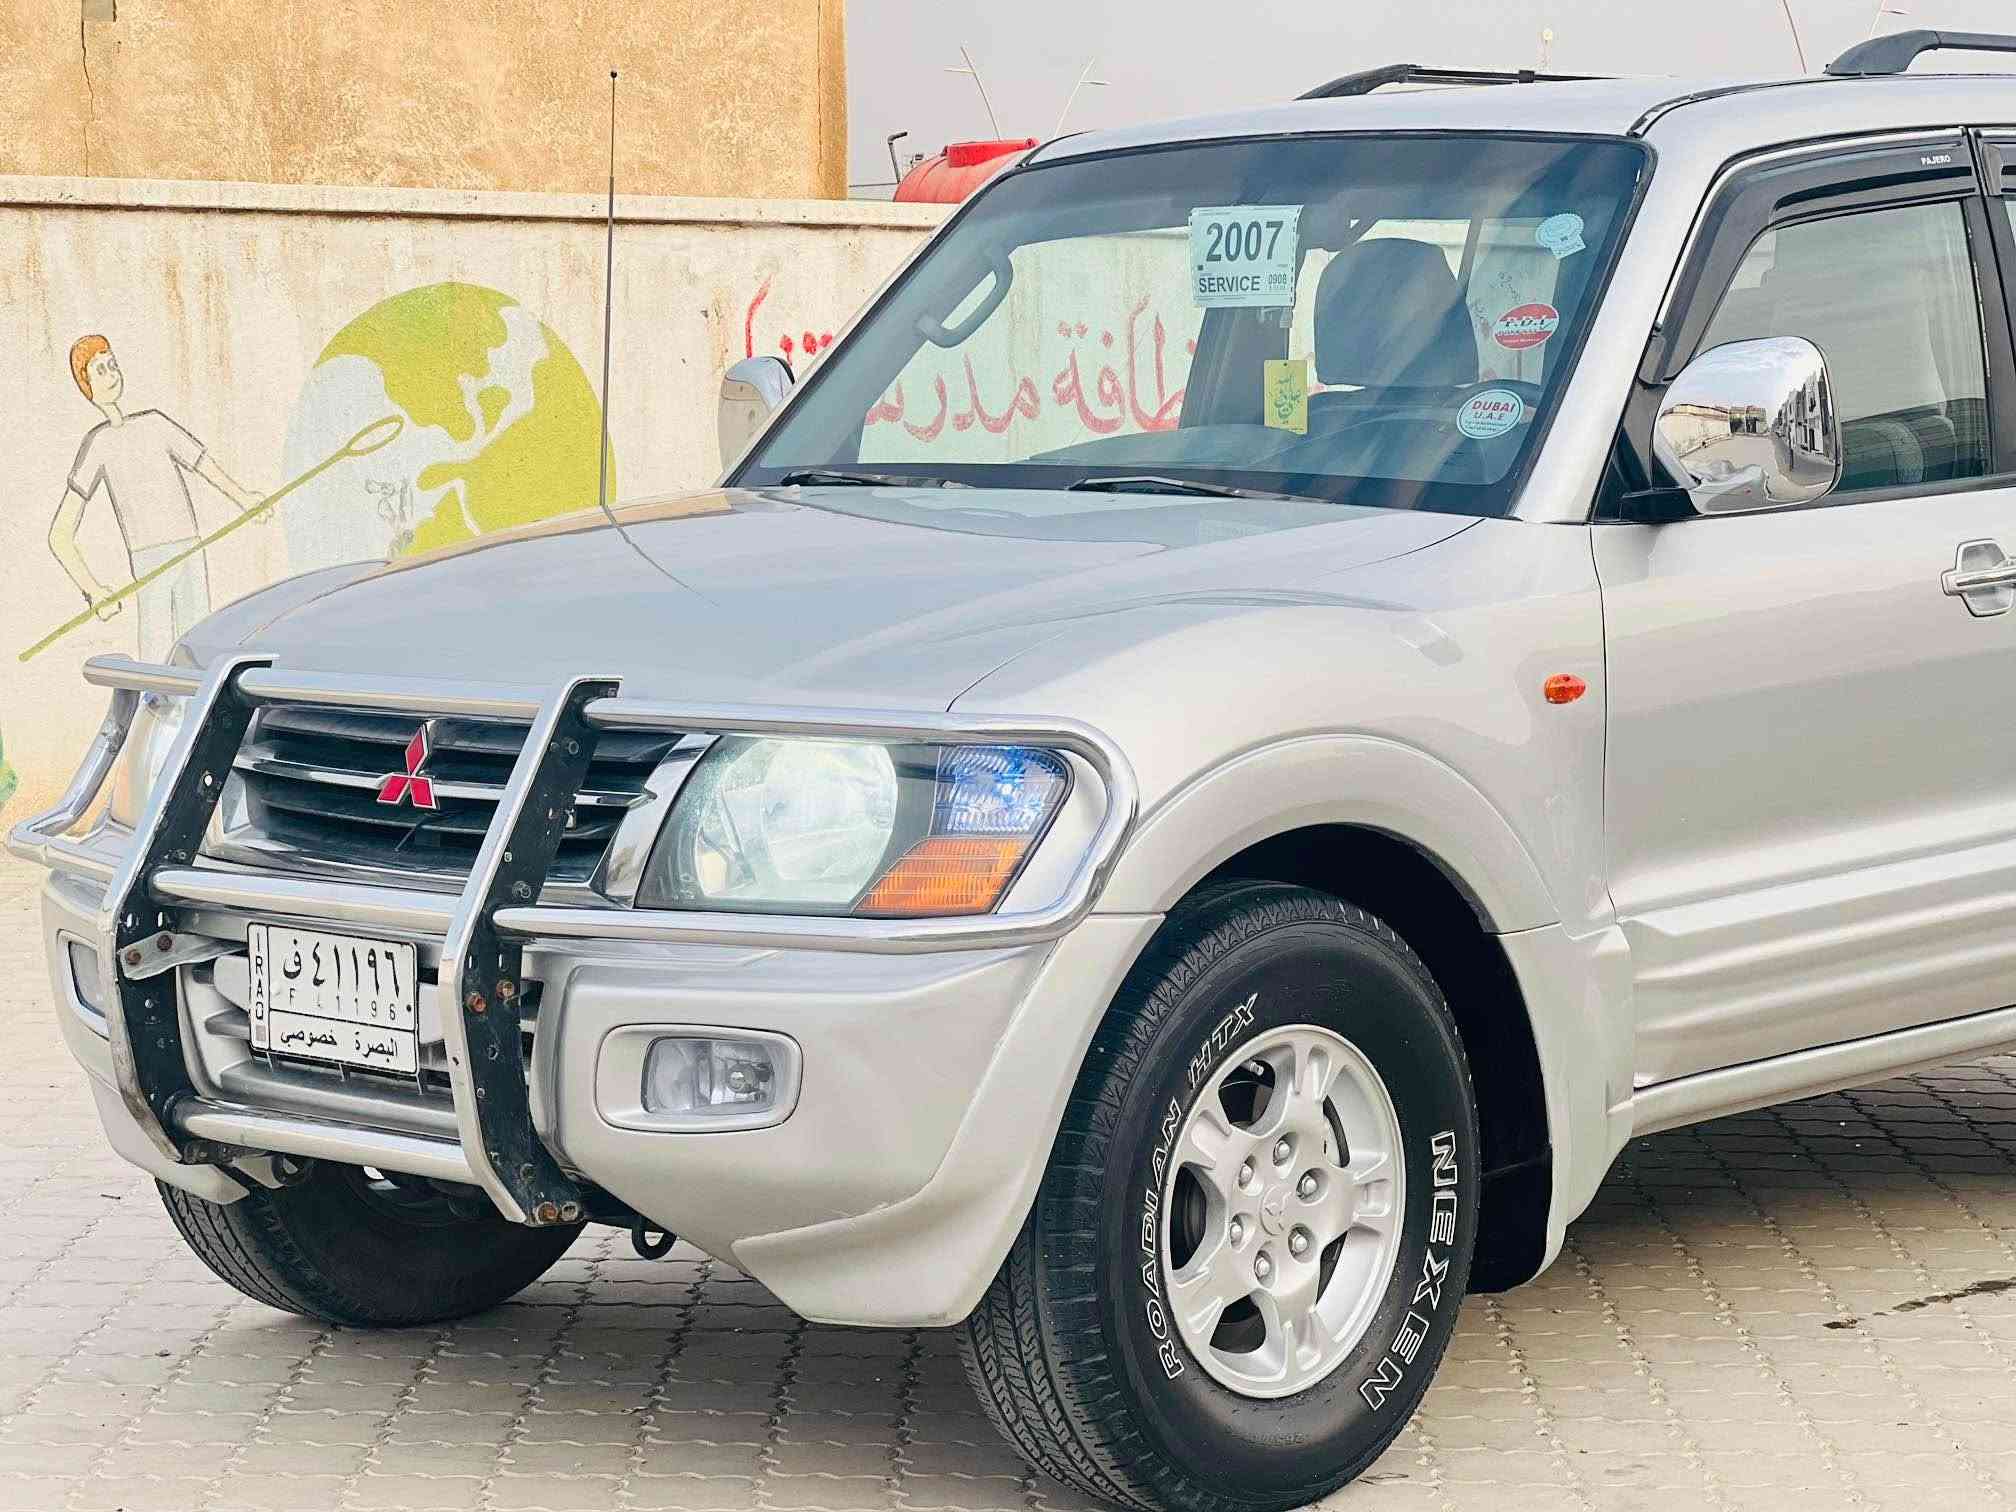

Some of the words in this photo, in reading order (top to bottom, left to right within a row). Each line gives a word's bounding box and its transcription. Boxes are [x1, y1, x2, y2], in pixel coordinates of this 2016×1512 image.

[1920, 154, 1952, 166] PAJERO
[1206, 220, 1284, 262] 2007
[1199, 275, 1261, 293] SERVICE
[1472, 400, 1516, 412] DUBAI
[255, 932, 264, 1021] IRAQ
[280, 1030, 338, 1048] خصوصي
[354, 1031, 398, 1063] البصرة
[1141, 1095, 1184, 1380] ROADIAN
[1188, 992, 1259, 1090] HTX
[1359, 1131, 1458, 1412] NEXEN
